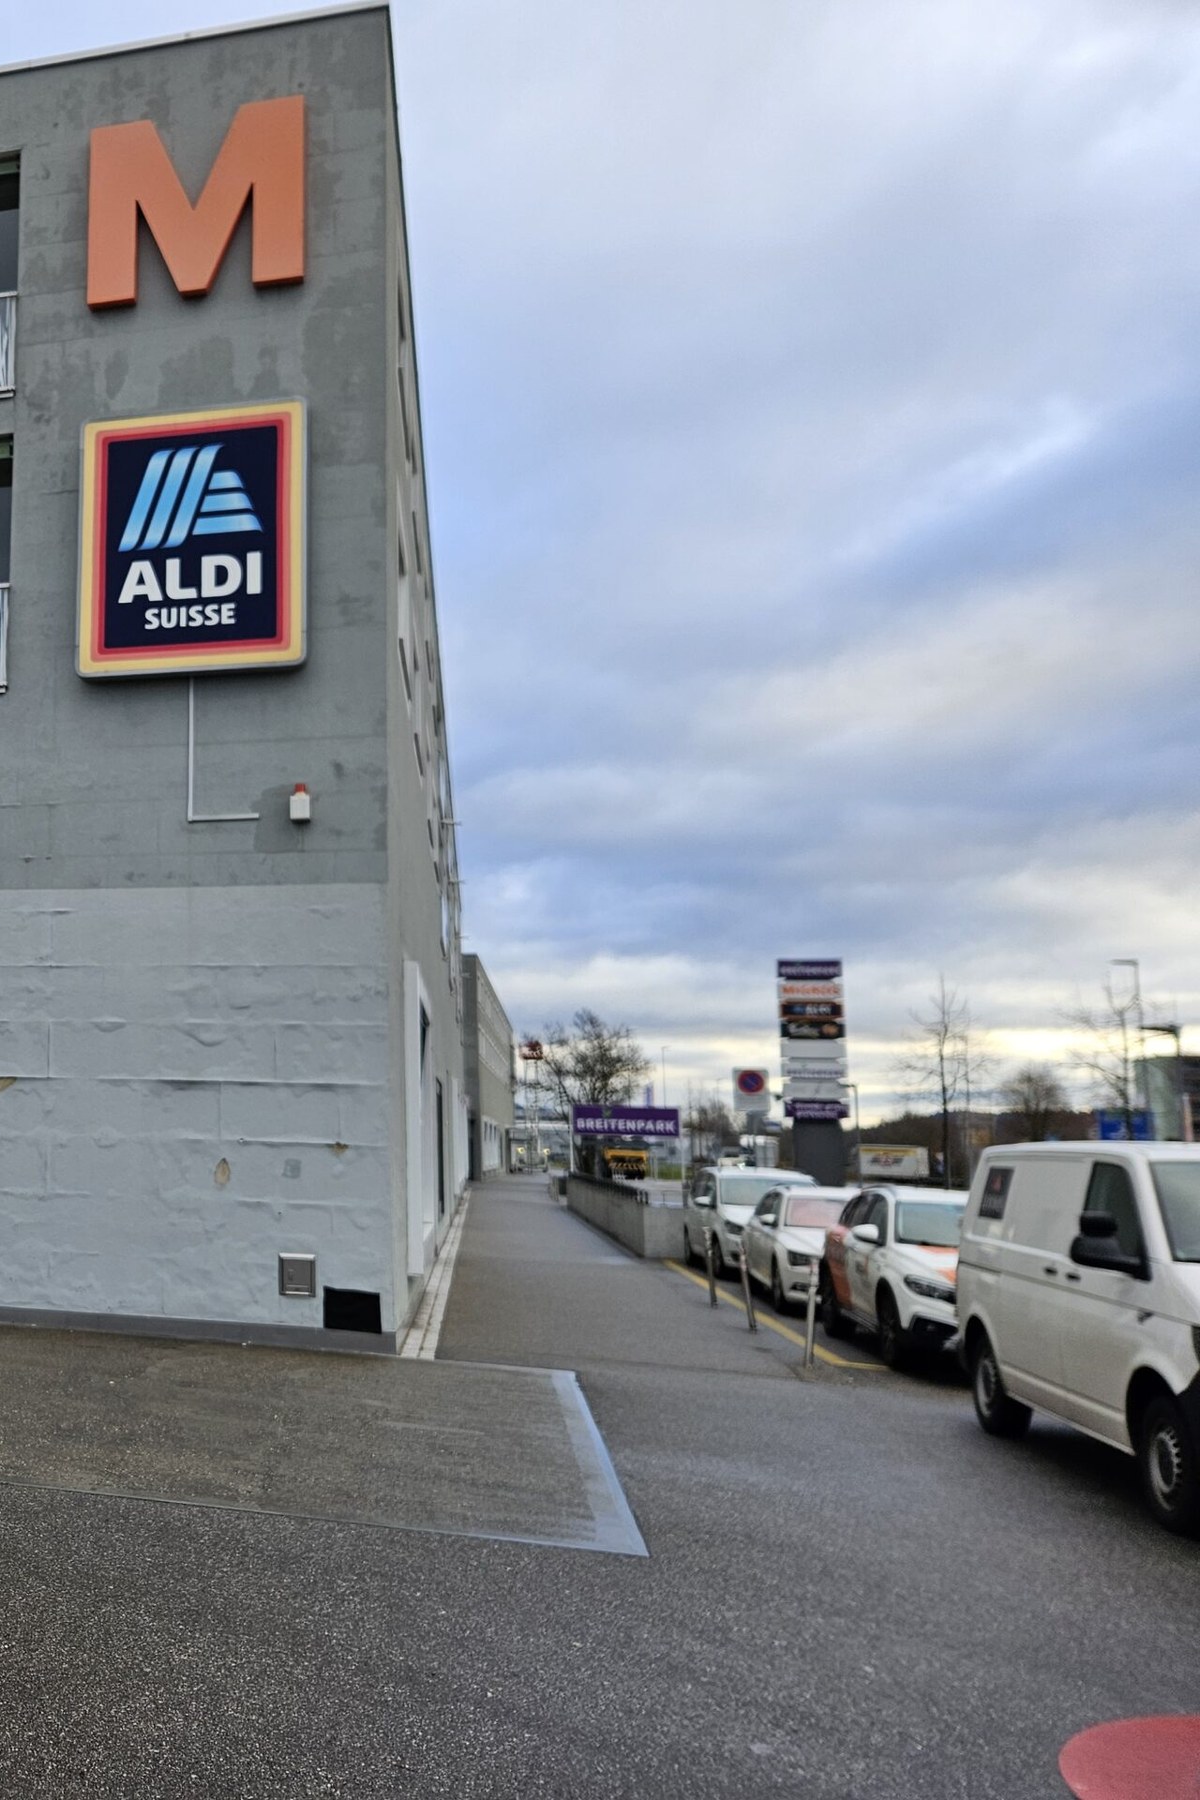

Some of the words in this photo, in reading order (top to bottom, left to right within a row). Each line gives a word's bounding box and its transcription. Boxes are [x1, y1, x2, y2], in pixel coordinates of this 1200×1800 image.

[87, 95, 305, 311] M
[118, 551, 262, 604] ALDI
[144, 602, 236, 630] SUISSE
[576, 1117, 675, 1133] BREITENPARK
